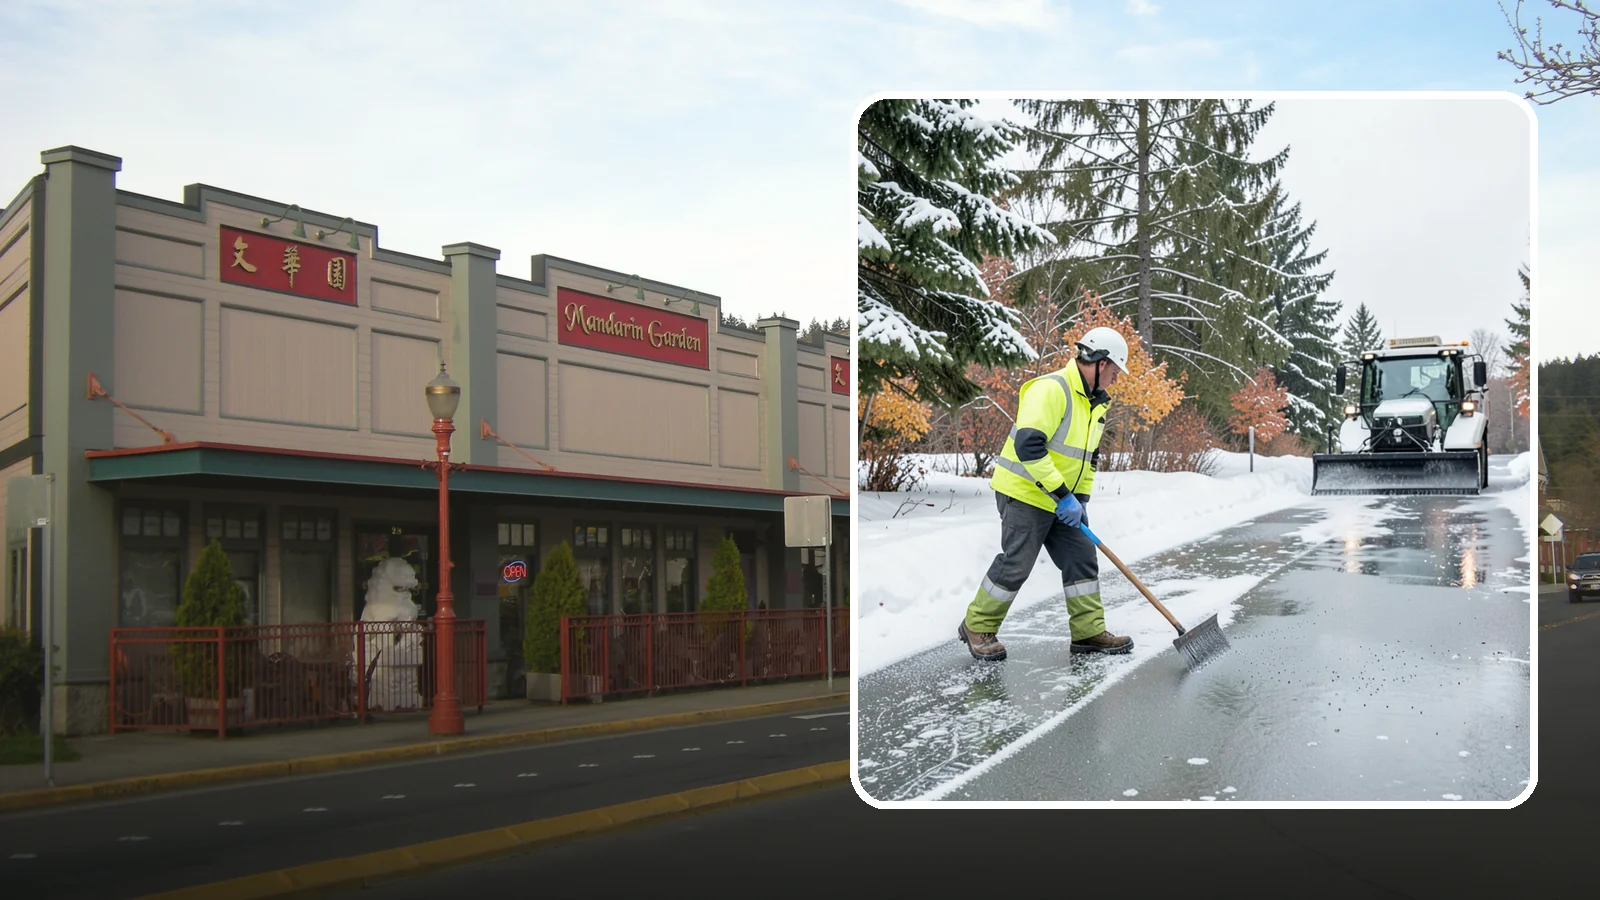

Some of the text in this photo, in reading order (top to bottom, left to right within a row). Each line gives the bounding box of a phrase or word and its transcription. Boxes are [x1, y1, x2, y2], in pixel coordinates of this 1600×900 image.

[564, 302, 701, 352] Mandarin Garden
[503, 565, 527, 578] OPEN
